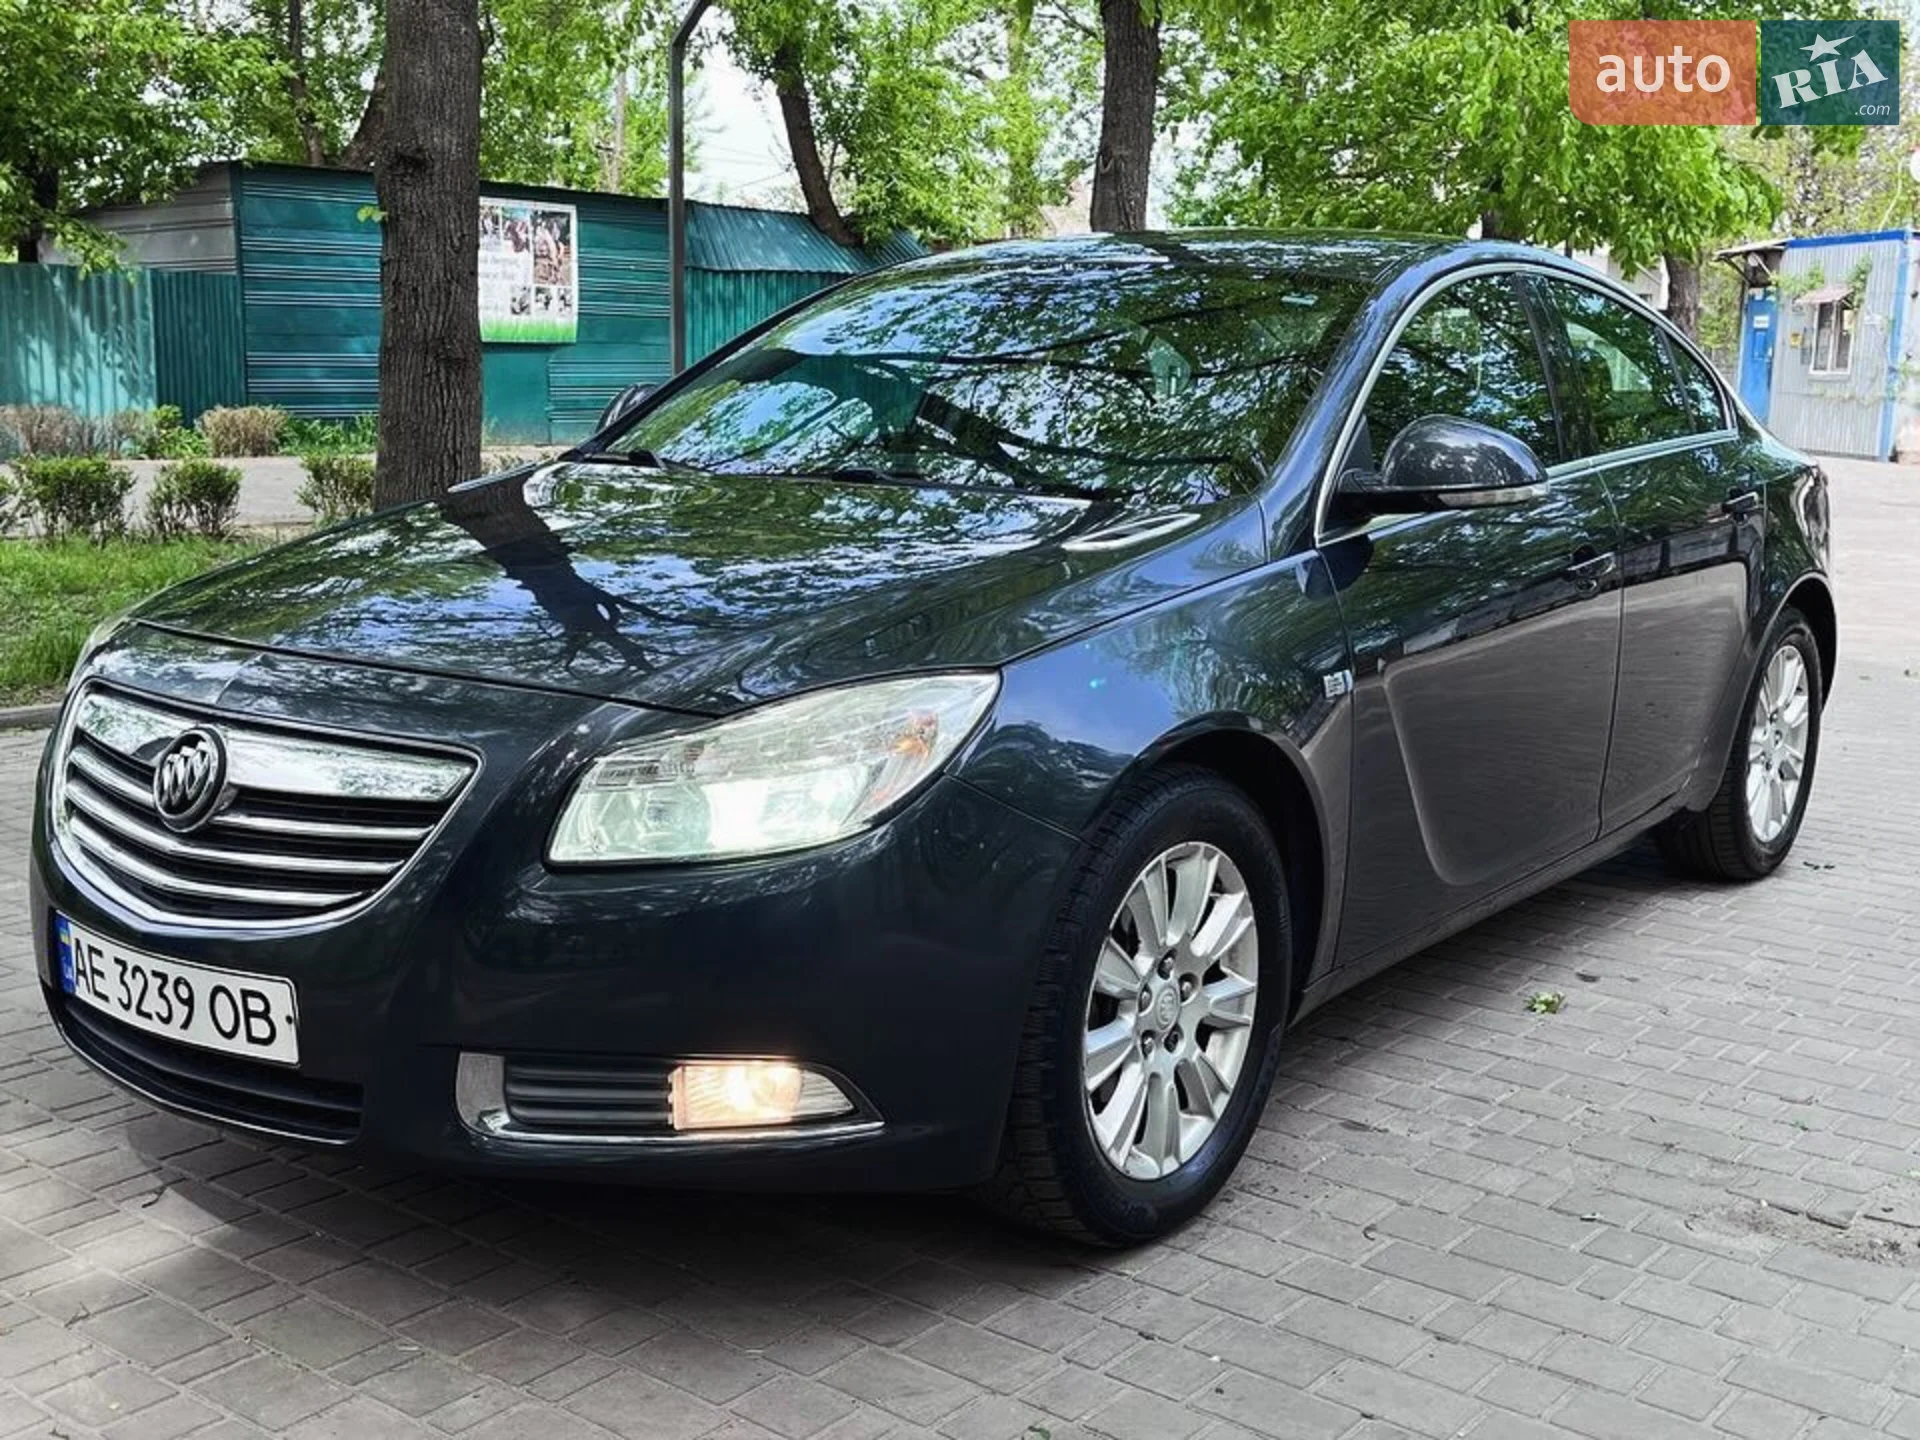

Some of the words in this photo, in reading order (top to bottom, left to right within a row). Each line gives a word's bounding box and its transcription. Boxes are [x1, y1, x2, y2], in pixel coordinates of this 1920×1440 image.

[74, 937, 111, 1004] AE
[113, 956, 195, 1031] 3239
[209, 984, 277, 1047] OB
